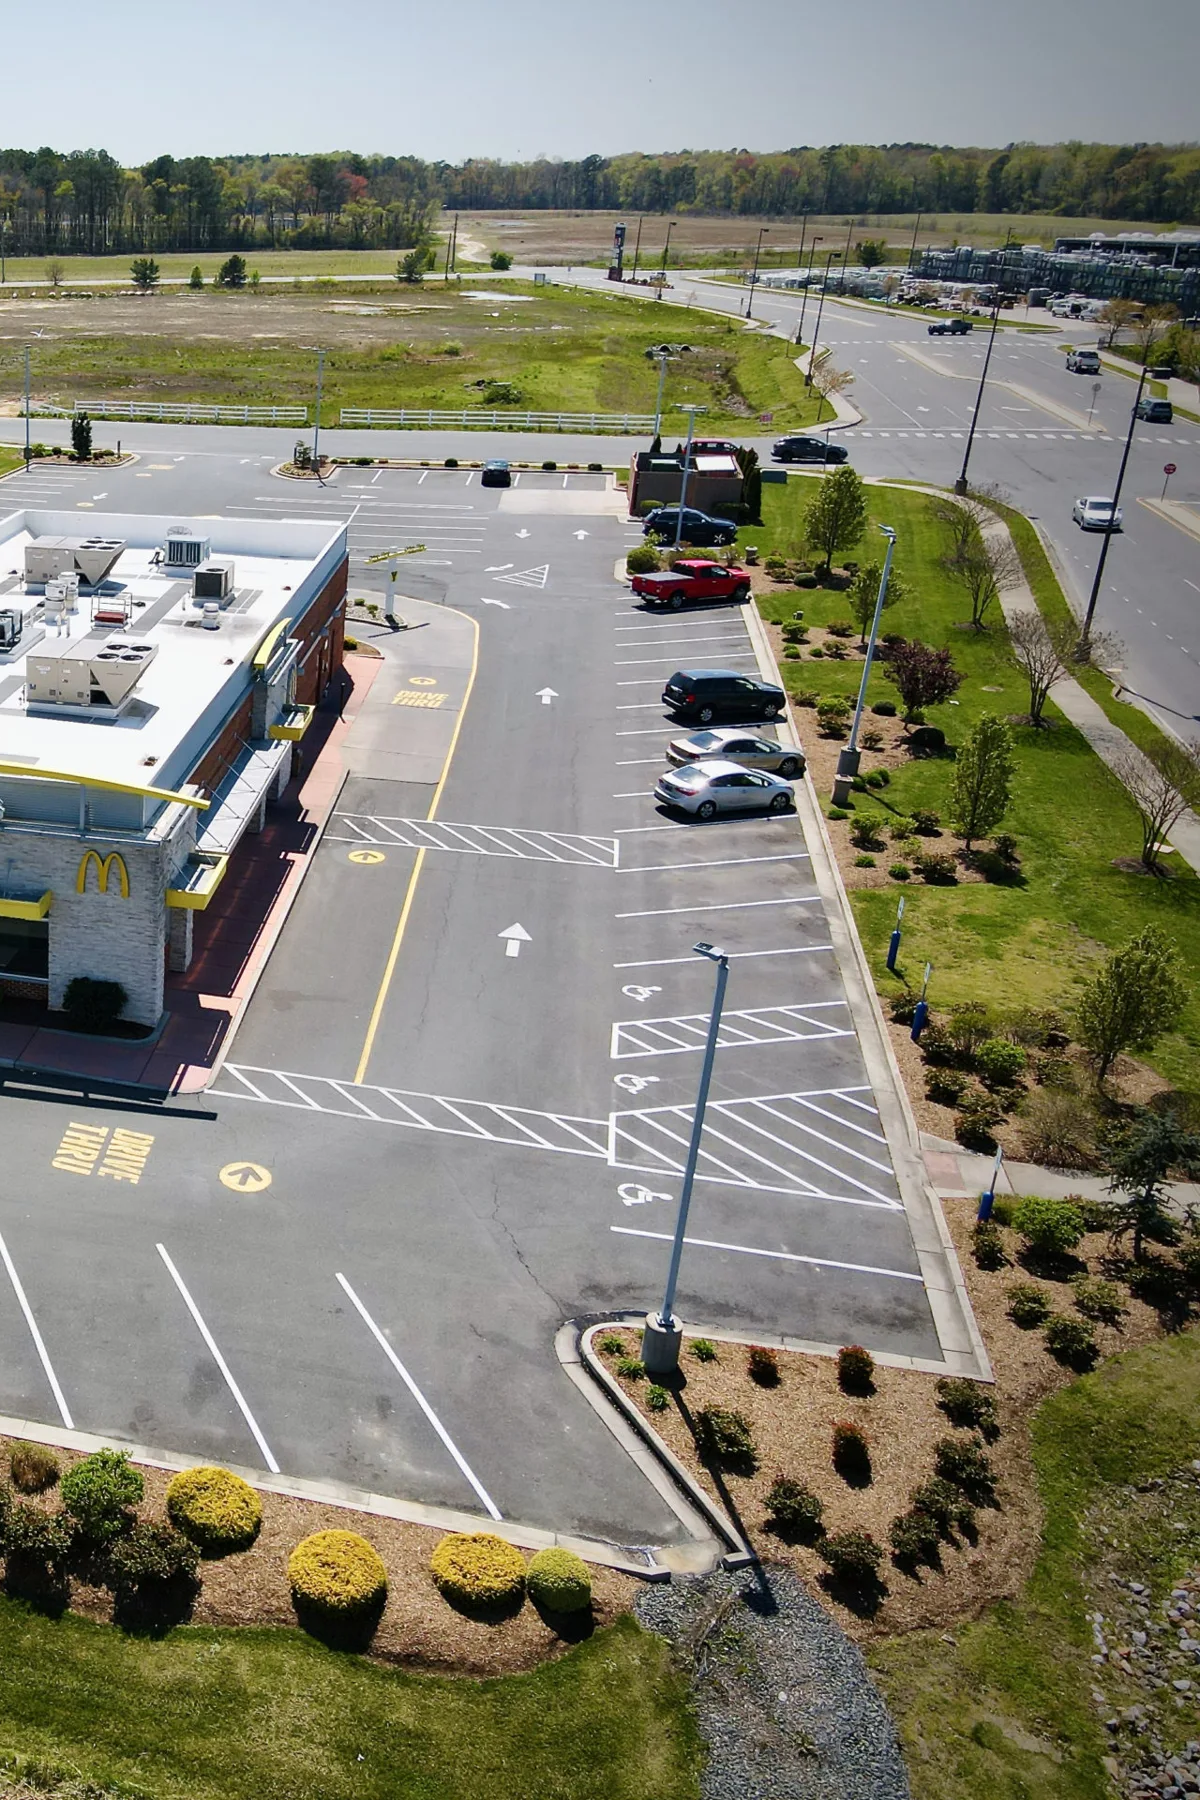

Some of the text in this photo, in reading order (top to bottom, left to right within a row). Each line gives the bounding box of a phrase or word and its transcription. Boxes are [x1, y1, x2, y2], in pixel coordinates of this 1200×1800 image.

[76, 849, 130, 898] M
[52, 1121, 109, 1175] THRU
[97, 1127, 155, 1184] DRIVE
